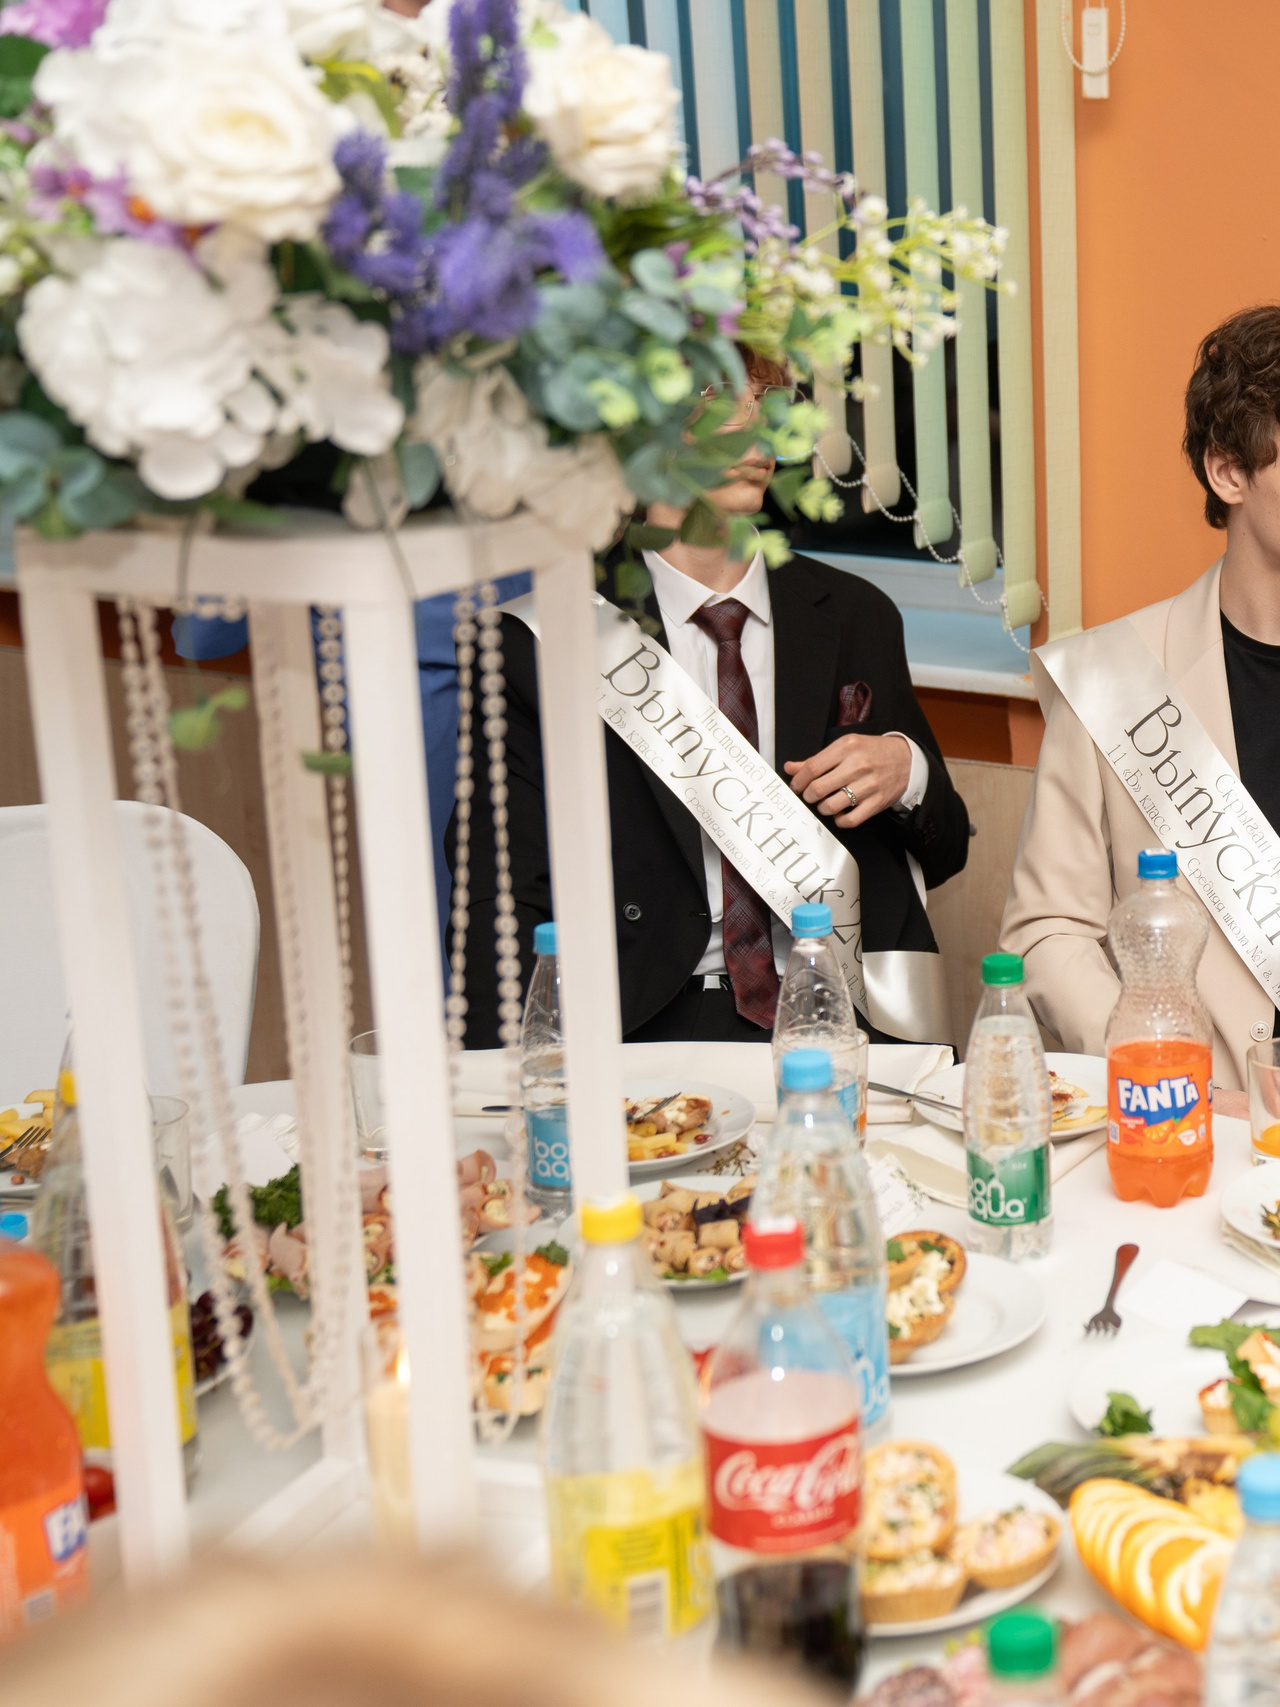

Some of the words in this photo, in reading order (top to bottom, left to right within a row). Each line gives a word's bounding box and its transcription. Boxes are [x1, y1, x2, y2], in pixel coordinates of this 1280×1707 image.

[601, 643, 845, 904] Выпускник
[626, 730, 663, 767] класс
[697, 706, 767, 782] Листопад
[762, 777, 797, 820] Иван
[1106, 744, 1127, 766] 11
[1139, 795, 1171, 836] класс
[684, 787, 726, 839] Средняя
[724, 839, 752, 871] школа
[1215, 773, 1272, 853] Скрыган
[1187, 858, 1225, 912] Средняя
[1222, 913, 1249, 947] школа
[1246, 945, 1267, 969] №1
[1117, 1076, 1199, 1112] FANTA
[534, 1136, 568, 1160] bo
